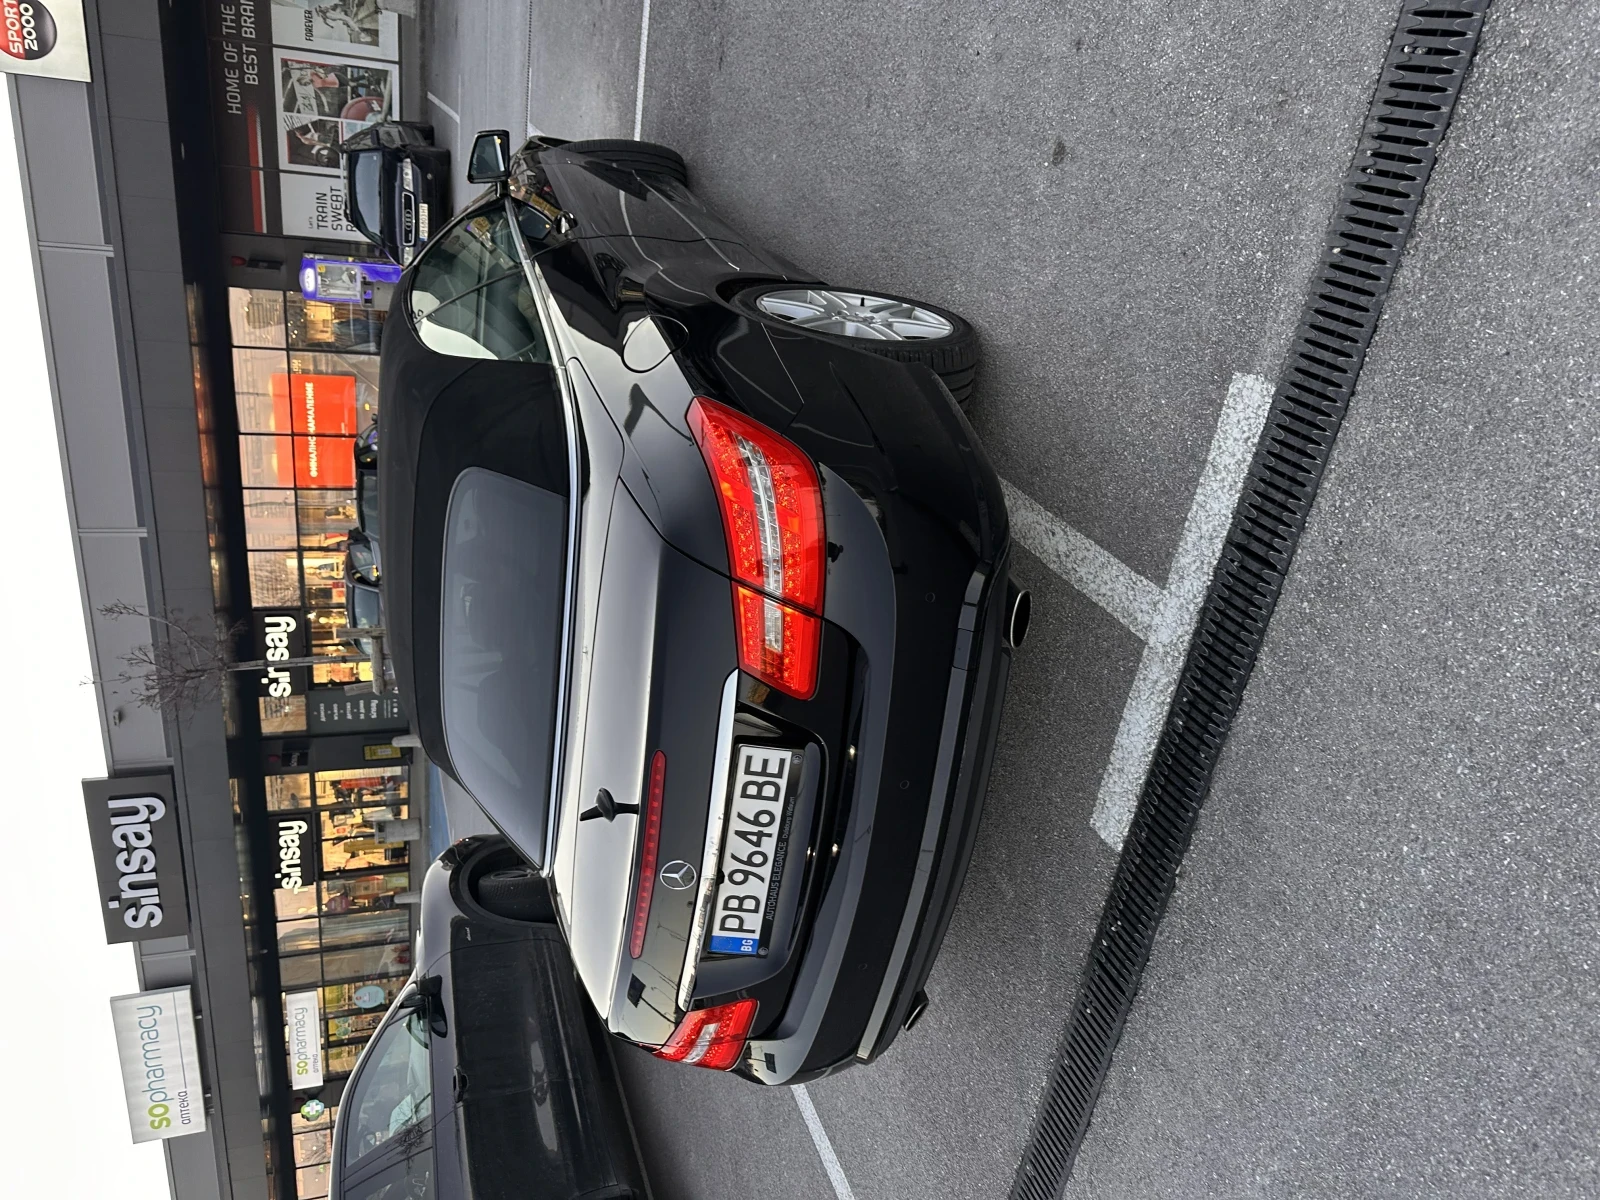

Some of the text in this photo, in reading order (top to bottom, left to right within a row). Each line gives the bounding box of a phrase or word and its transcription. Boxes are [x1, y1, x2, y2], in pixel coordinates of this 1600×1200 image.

[19, 3, 38, 51] 2000
[303, 9, 314, 42] FOREVER
[220, 3, 242, 115] HOME OF THE
[242, 43, 259, 85] BEST
[315, 192, 328, 230] TRAIN
[330, 185, 343, 231] SWEAT
[369, 699, 379, 719] sinsay
[107, 797, 166, 929] sinsay
[274, 820, 308, 889] sinsay
[719, 755, 785, 934] PB 9646 BE
[765, 882, 779, 920] AUTOHAUS
[773, 842, 787, 880] ELEGANCE
[740, 939, 753, 951] BG
[294, 1007, 311, 1076] sopharmacy
[136, 1005, 174, 1130] sopharmacy
[177, 1090, 191, 1125] аптека
